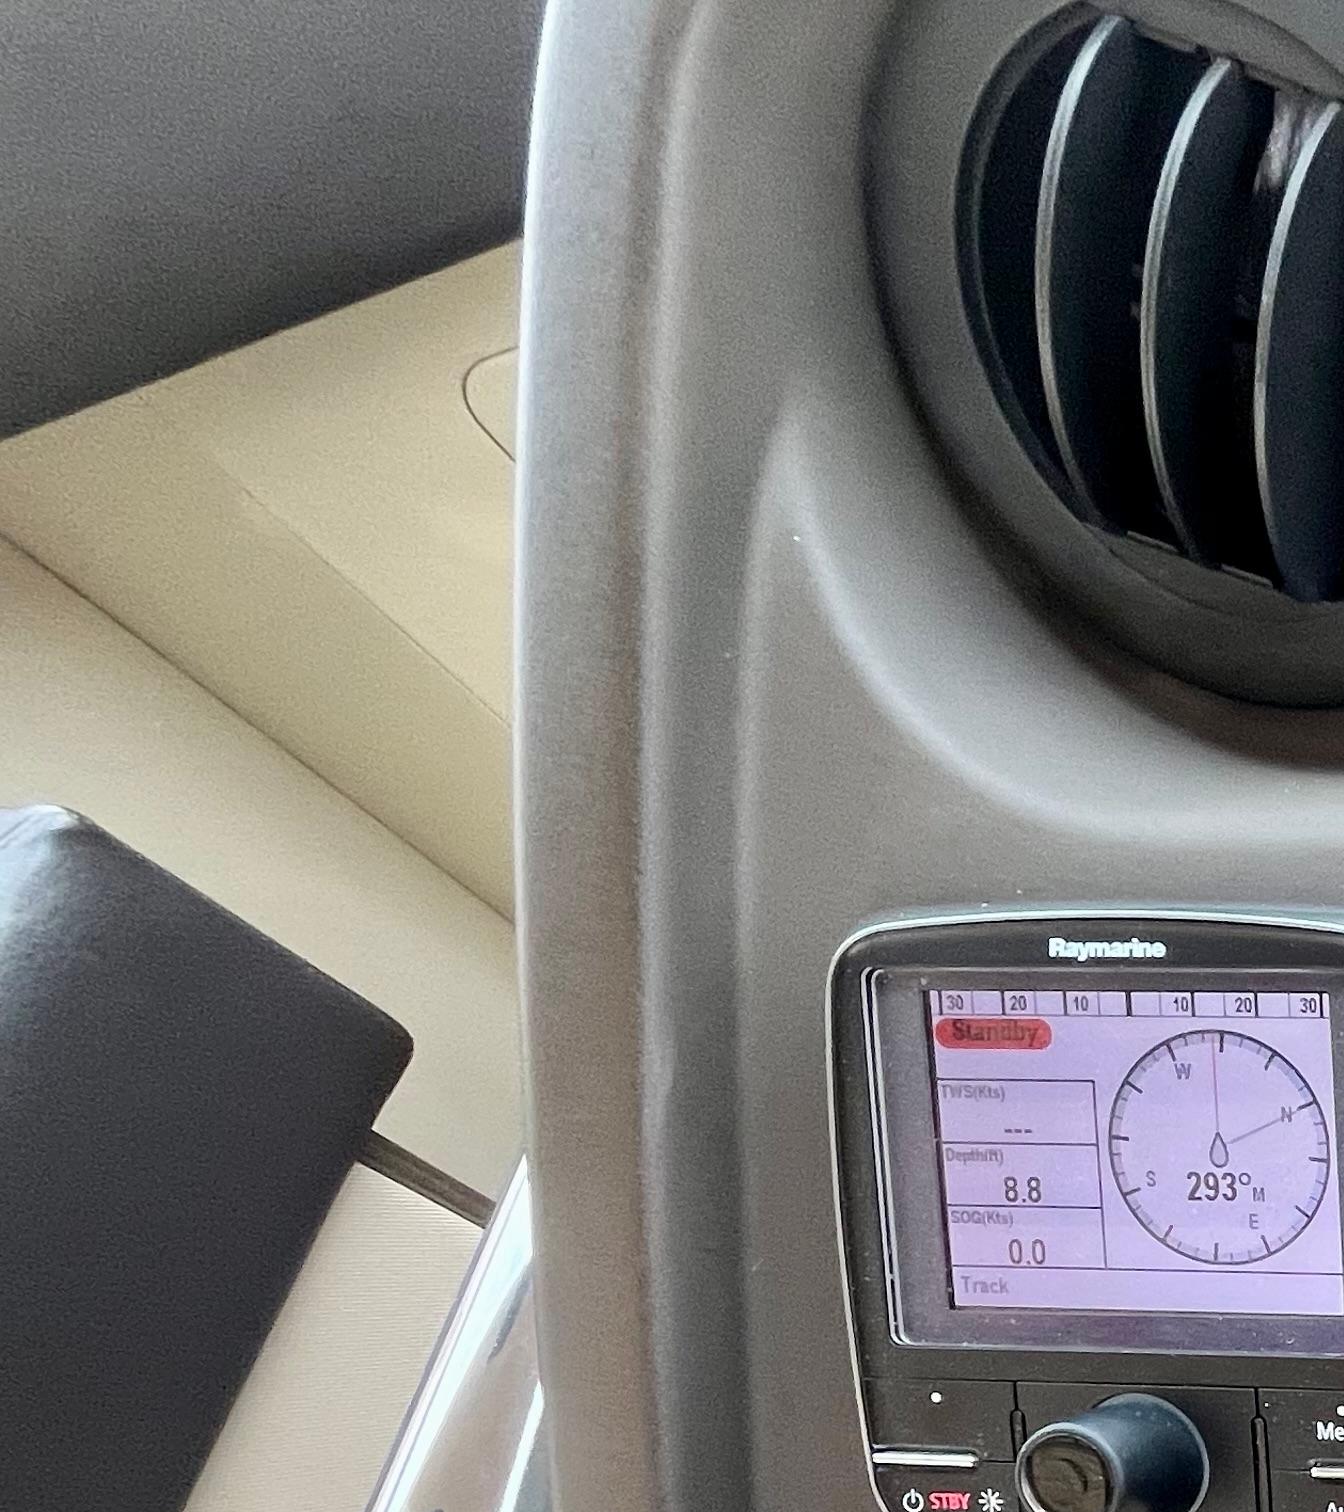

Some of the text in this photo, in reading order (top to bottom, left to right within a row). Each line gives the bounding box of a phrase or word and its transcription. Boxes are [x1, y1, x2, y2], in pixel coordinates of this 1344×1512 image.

[1047, 936, 1167, 963] Raymarine
[947, 994, 1317, 1013] 30 20 10 10 20 30
[951, 1019, 1040, 1046] Standby
[1174, 1062, 1192, 1081] W
[1280, 1106, 1293, 1123] N
[1145, 1170, 1157, 1188] S
[1003, 1176, 1042, 1203] 8.8
[1249, 1213, 1260, 1231] E
[1008, 1238, 1046, 1265] 0.0
[960, 1276, 1010, 1294] Track
[929, 1492, 971, 1511] STBY
